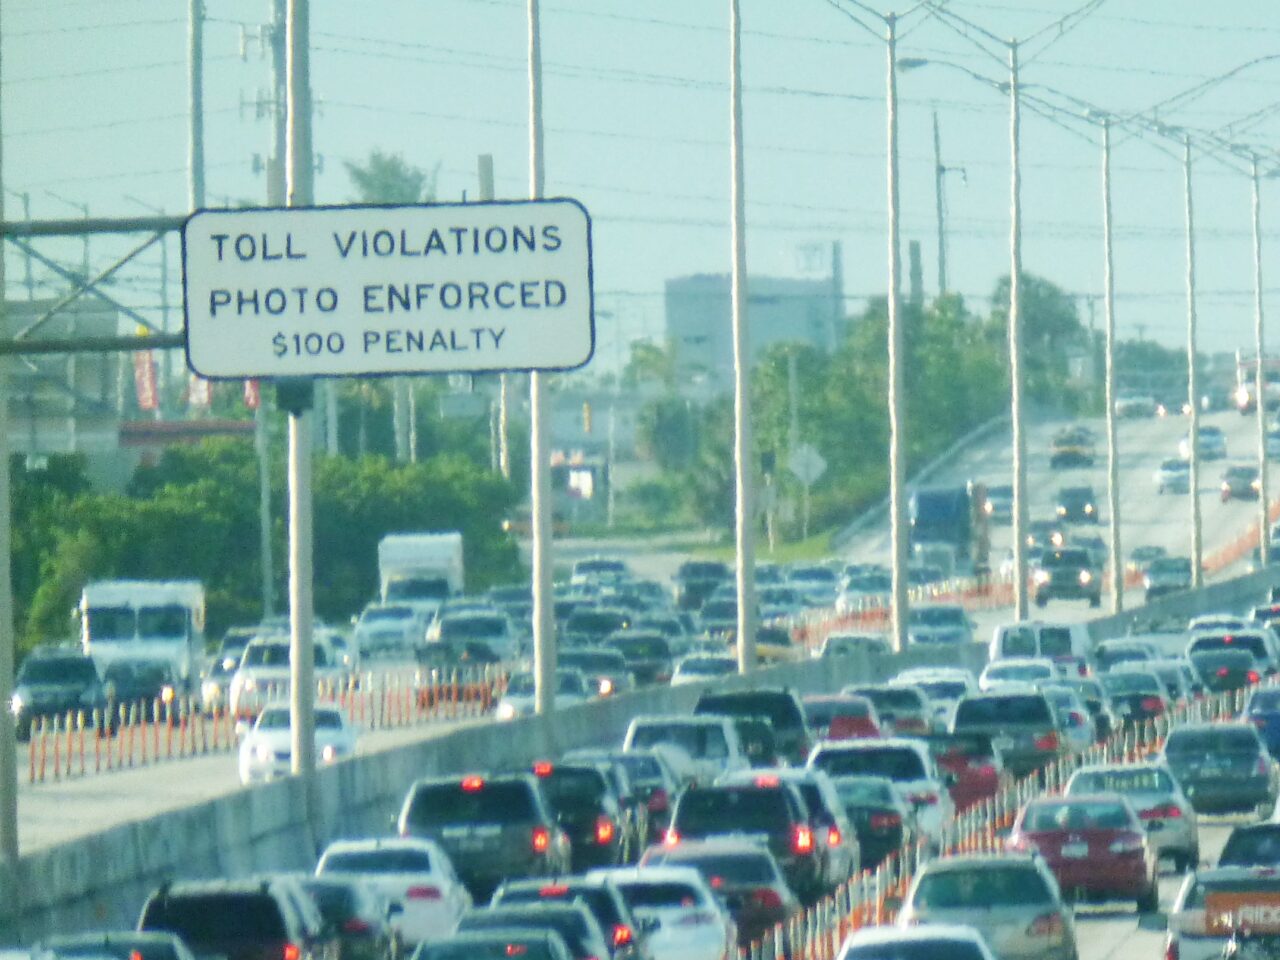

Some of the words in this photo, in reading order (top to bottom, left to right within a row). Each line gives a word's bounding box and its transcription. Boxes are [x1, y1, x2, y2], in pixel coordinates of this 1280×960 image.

[210, 232, 307, 262] TOLL
[333, 224, 563, 259] VIOLATIONS
[208, 286, 339, 318] PHOTO
[363, 279, 567, 314] ENFORCED
[272, 331, 345, 358] $100
[363, 327, 507, 354] PENALTY
